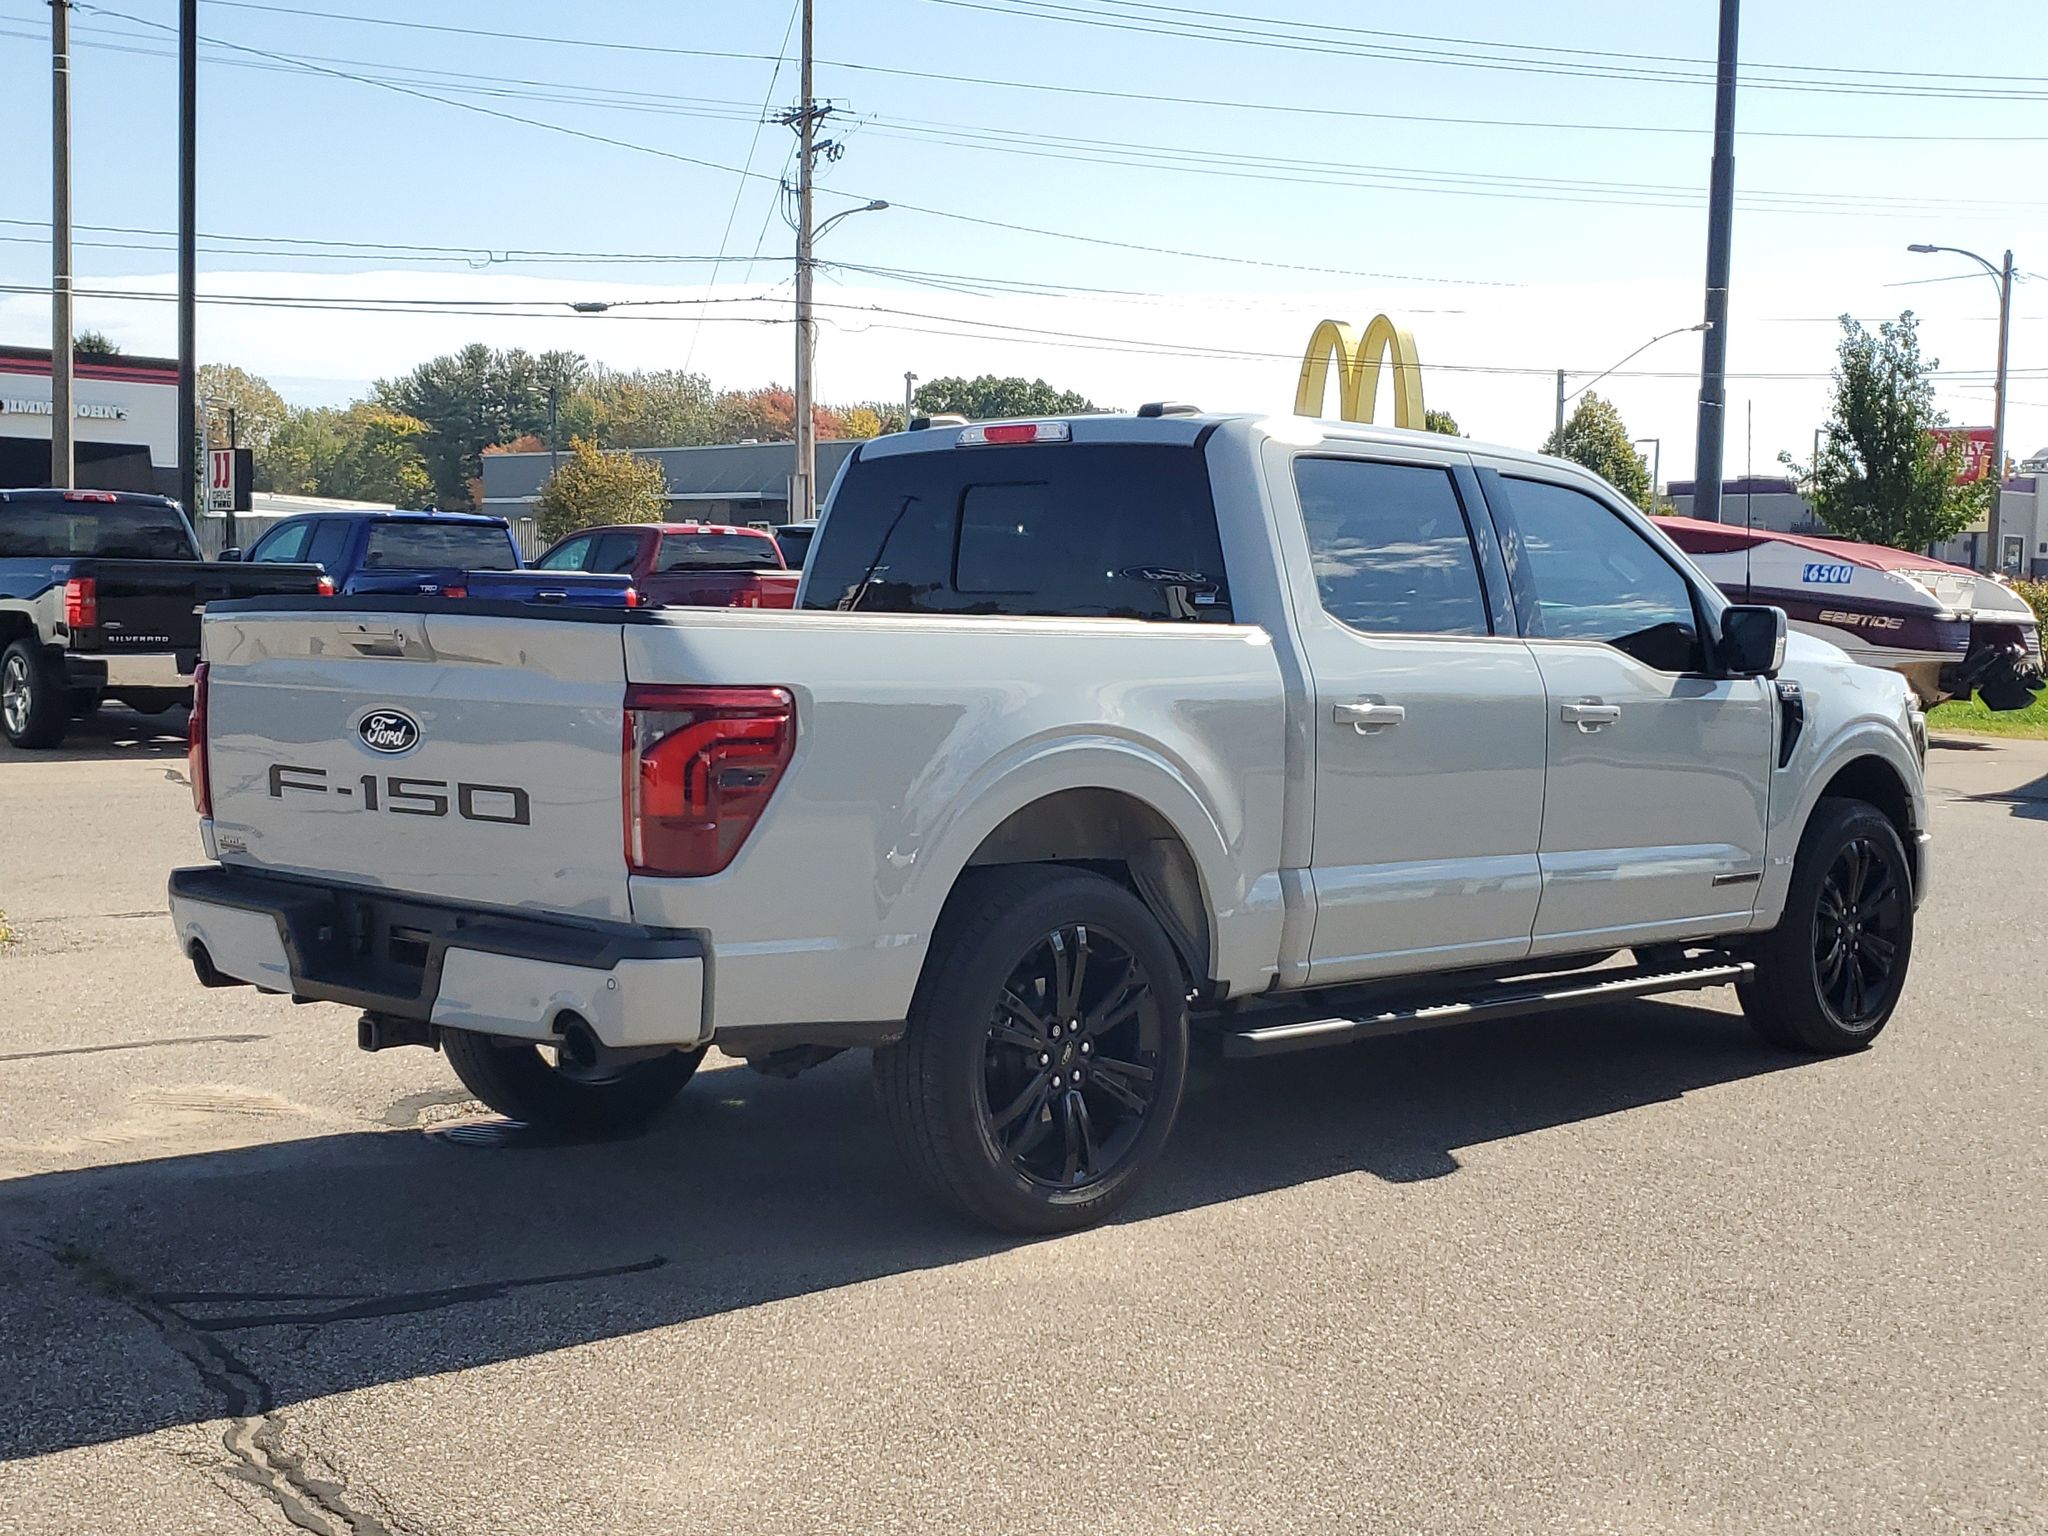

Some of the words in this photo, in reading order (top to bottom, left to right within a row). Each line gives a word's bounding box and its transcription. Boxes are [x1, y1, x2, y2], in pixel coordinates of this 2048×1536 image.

[2, 399, 54, 416] JIMM
[213, 452, 230, 489] JJ
[212, 500, 232, 509] THRU
[419, 584, 438, 592] TRD
[107, 635, 170, 643] SILVERADO
[366, 715, 407, 747] Ford
[268, 763, 531, 826] F-150
